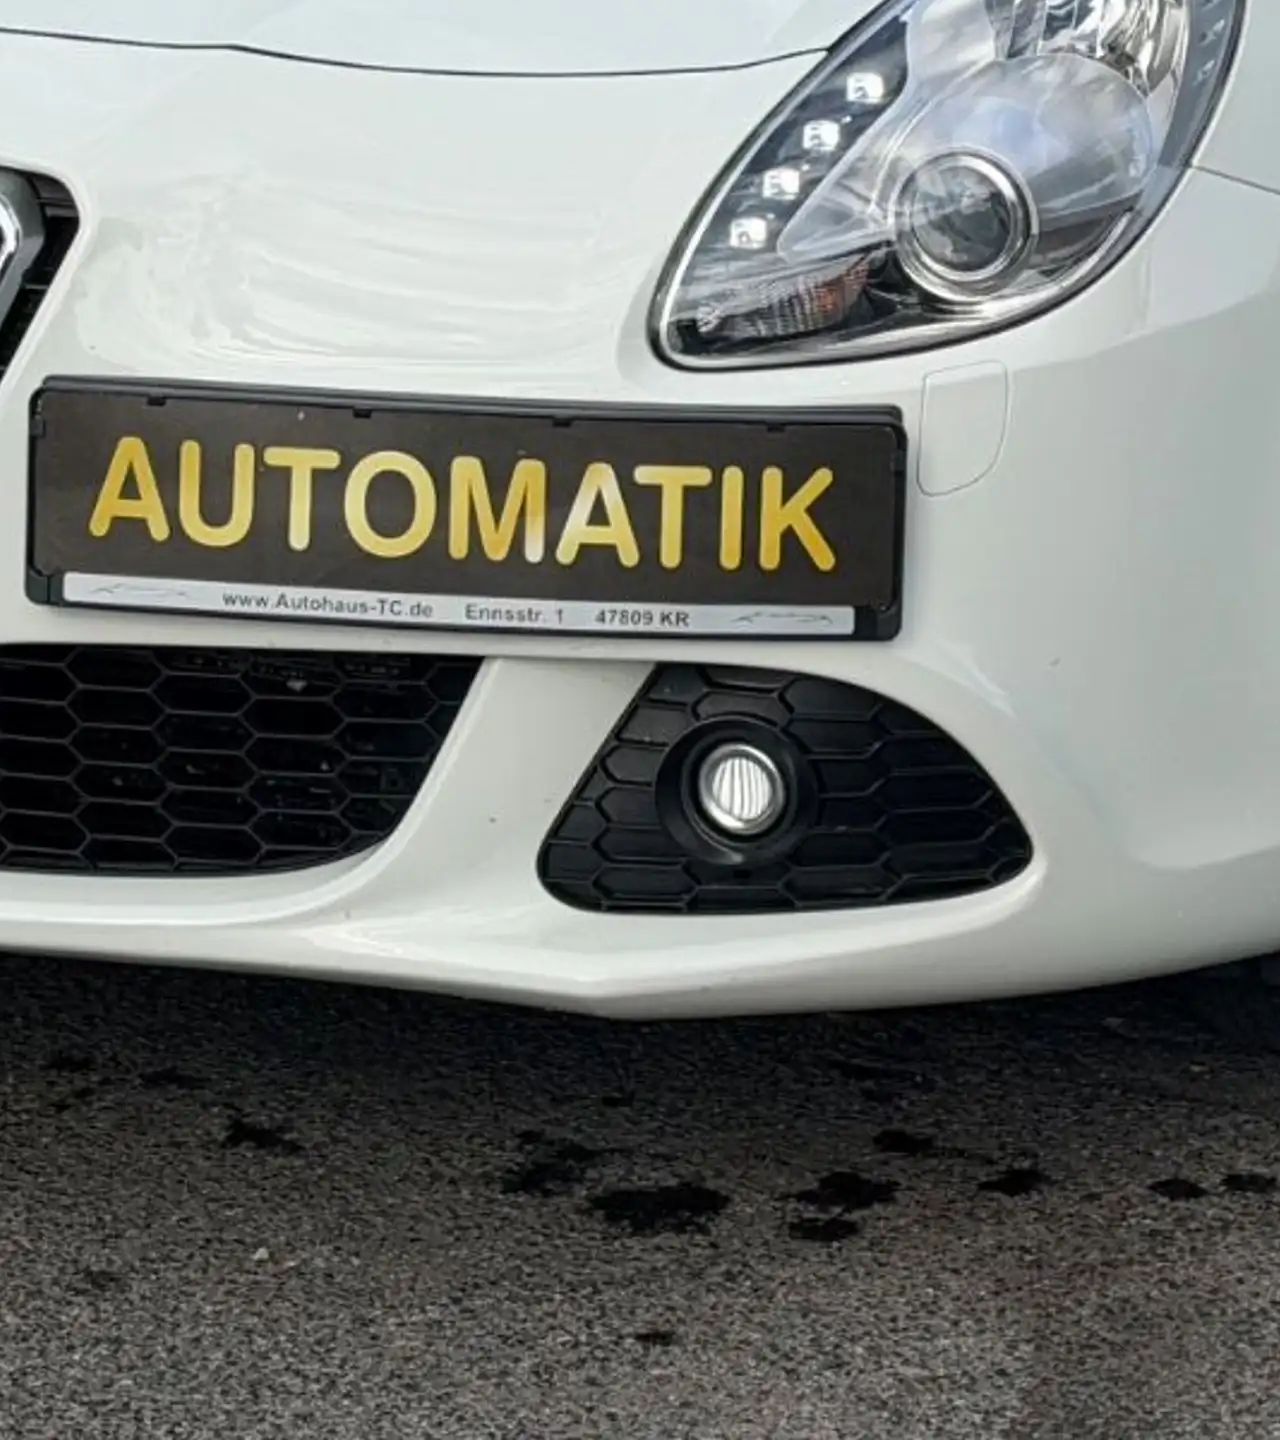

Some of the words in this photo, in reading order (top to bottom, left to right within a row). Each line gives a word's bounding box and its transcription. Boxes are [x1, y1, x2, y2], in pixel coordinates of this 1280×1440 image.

[88, 436, 837, 572] AUTOMATIK
[222, 591, 433, 619] www.Autohaus-TC.de
[464, 603, 548, 624] Ennsstr.
[556, 609, 565, 625] 1
[594, 609, 654, 626] 47809
[659, 611, 691, 627] KR
